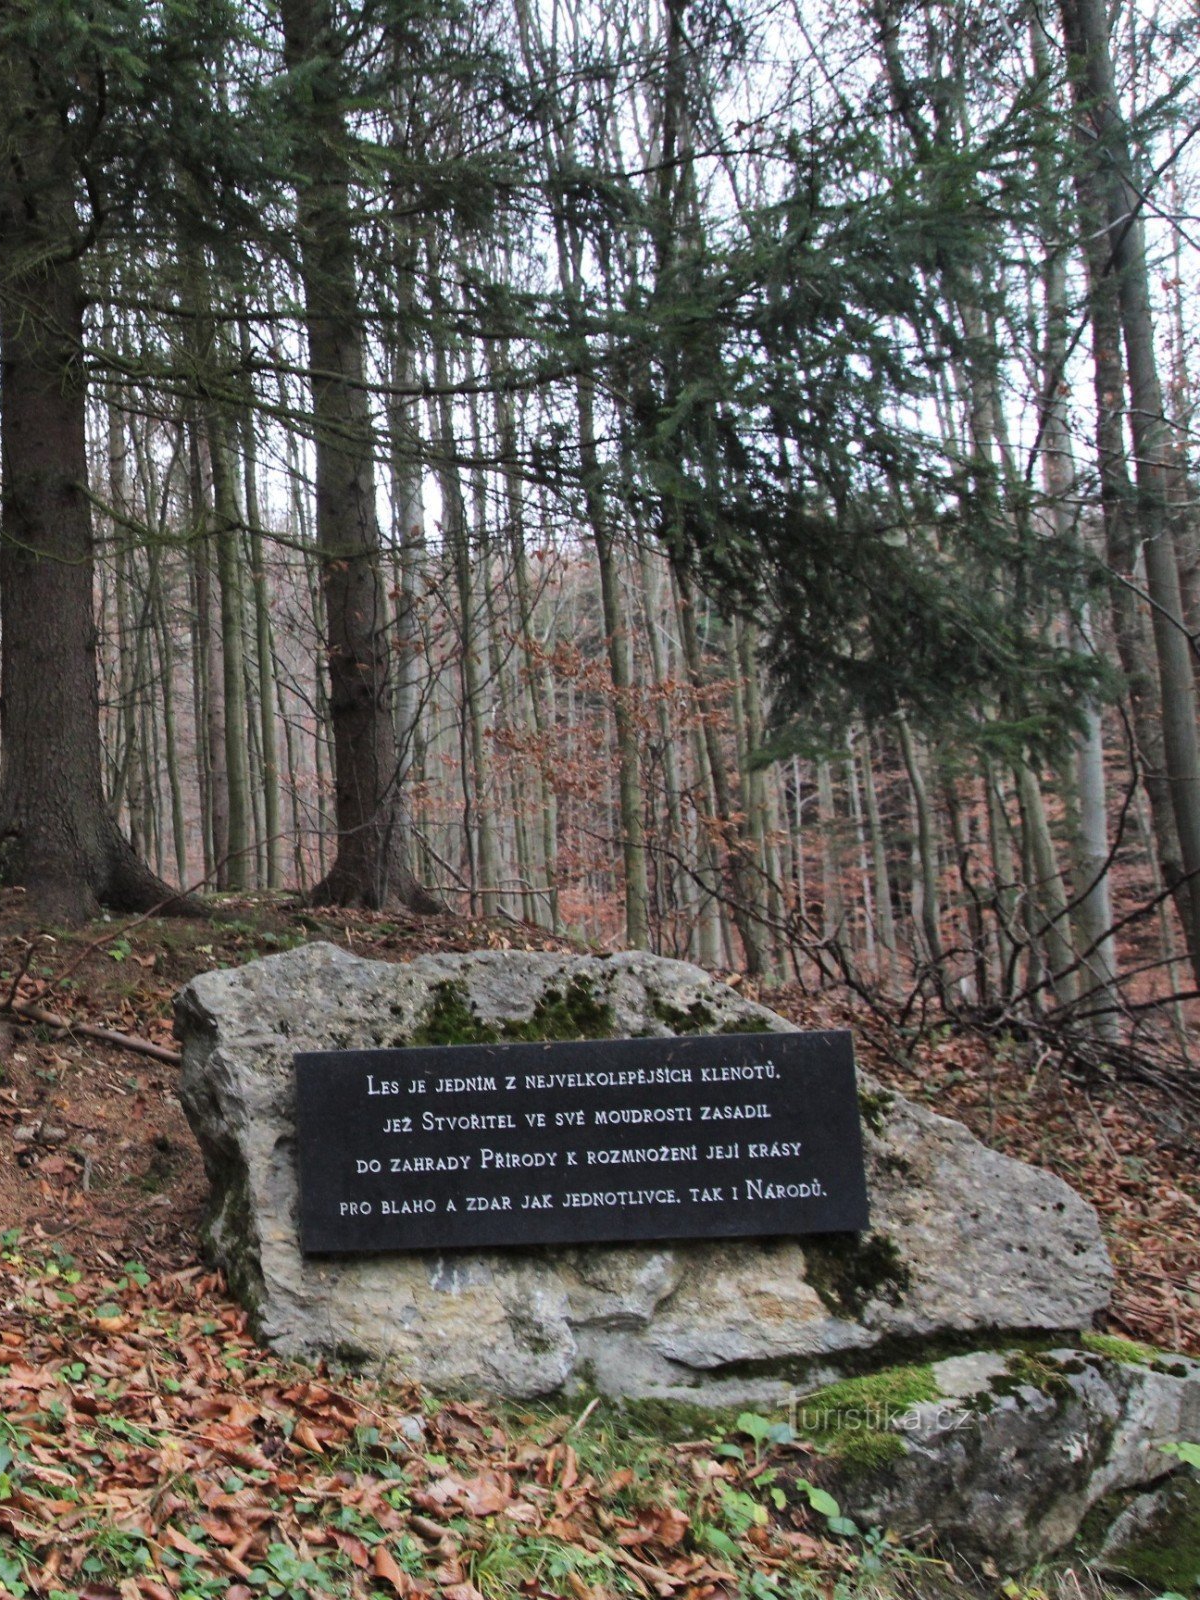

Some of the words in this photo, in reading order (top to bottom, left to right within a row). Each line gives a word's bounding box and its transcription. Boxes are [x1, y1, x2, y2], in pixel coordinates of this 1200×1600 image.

[408, 1080, 426, 1094] JE
[435, 1075, 497, 1093] JEDNÍM
[505, 1076, 516, 1090] Z
[525, 1113, 546, 1127] VE
[595, 1107, 692, 1125] MOUDROSTI
[700, 1104, 771, 1120] ZASADIL
[356, 1159, 382, 1173] DO
[390, 1155, 471, 1173] ZAHRADY
[567, 1151, 578, 1165] K
[340, 1201, 372, 1215] PRO
[381, 1199, 437, 1214] BLAHO
[446, 1199, 457, 1212] A
[466, 1196, 512, 1211] ZDAR
[521, 1194, 553, 1209] JAK
[689, 1187, 724, 1202] TAK
